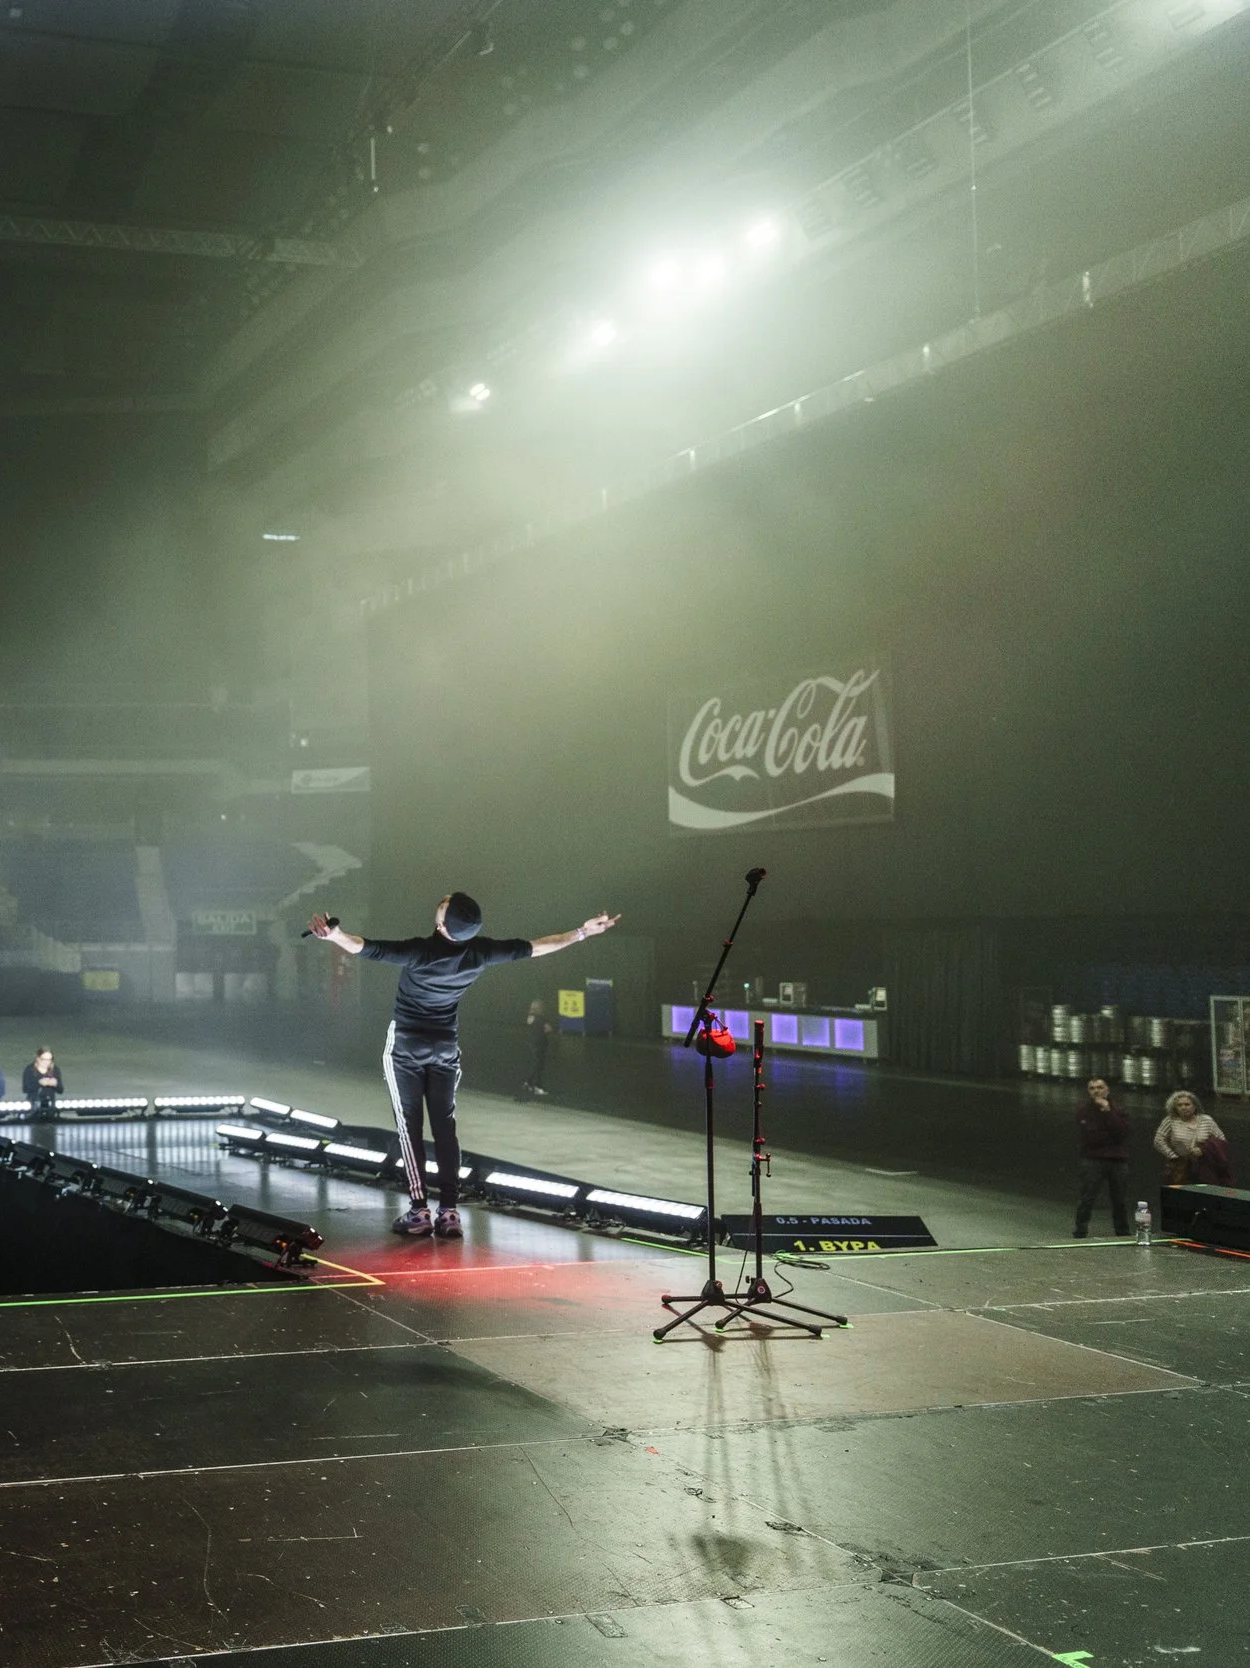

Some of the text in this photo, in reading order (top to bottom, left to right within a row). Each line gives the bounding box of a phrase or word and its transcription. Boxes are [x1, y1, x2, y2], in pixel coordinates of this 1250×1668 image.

[679, 669, 880, 788] Coca-Cola
[776, 1216, 799, 1225] 0.5
[810, 1217, 872, 1225] PASADA
[794, 1240, 816, 1252] 1.
